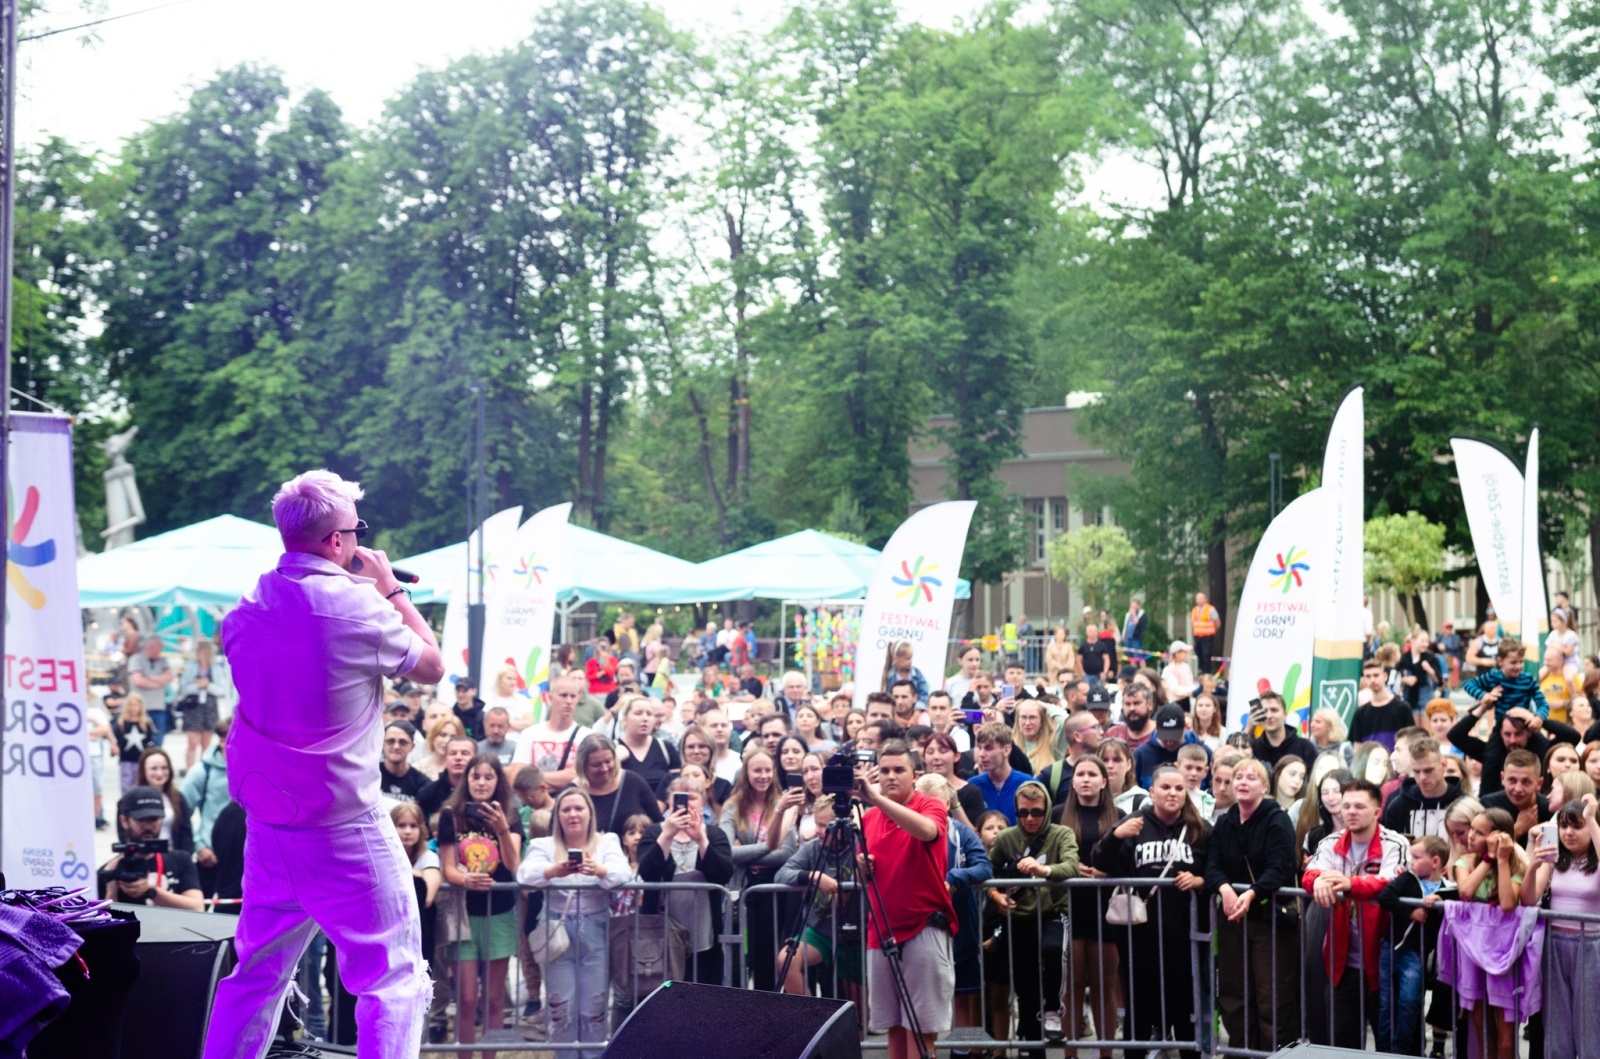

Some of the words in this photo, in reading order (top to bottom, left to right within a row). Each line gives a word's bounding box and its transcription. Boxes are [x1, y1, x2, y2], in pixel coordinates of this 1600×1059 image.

[1256, 602, 1310, 613] FESTIWAL
[880, 612, 941, 631] FESTIWAL
[1252, 627, 1286, 639] ODRY
[1134, 838, 1195, 869] CHICAG
